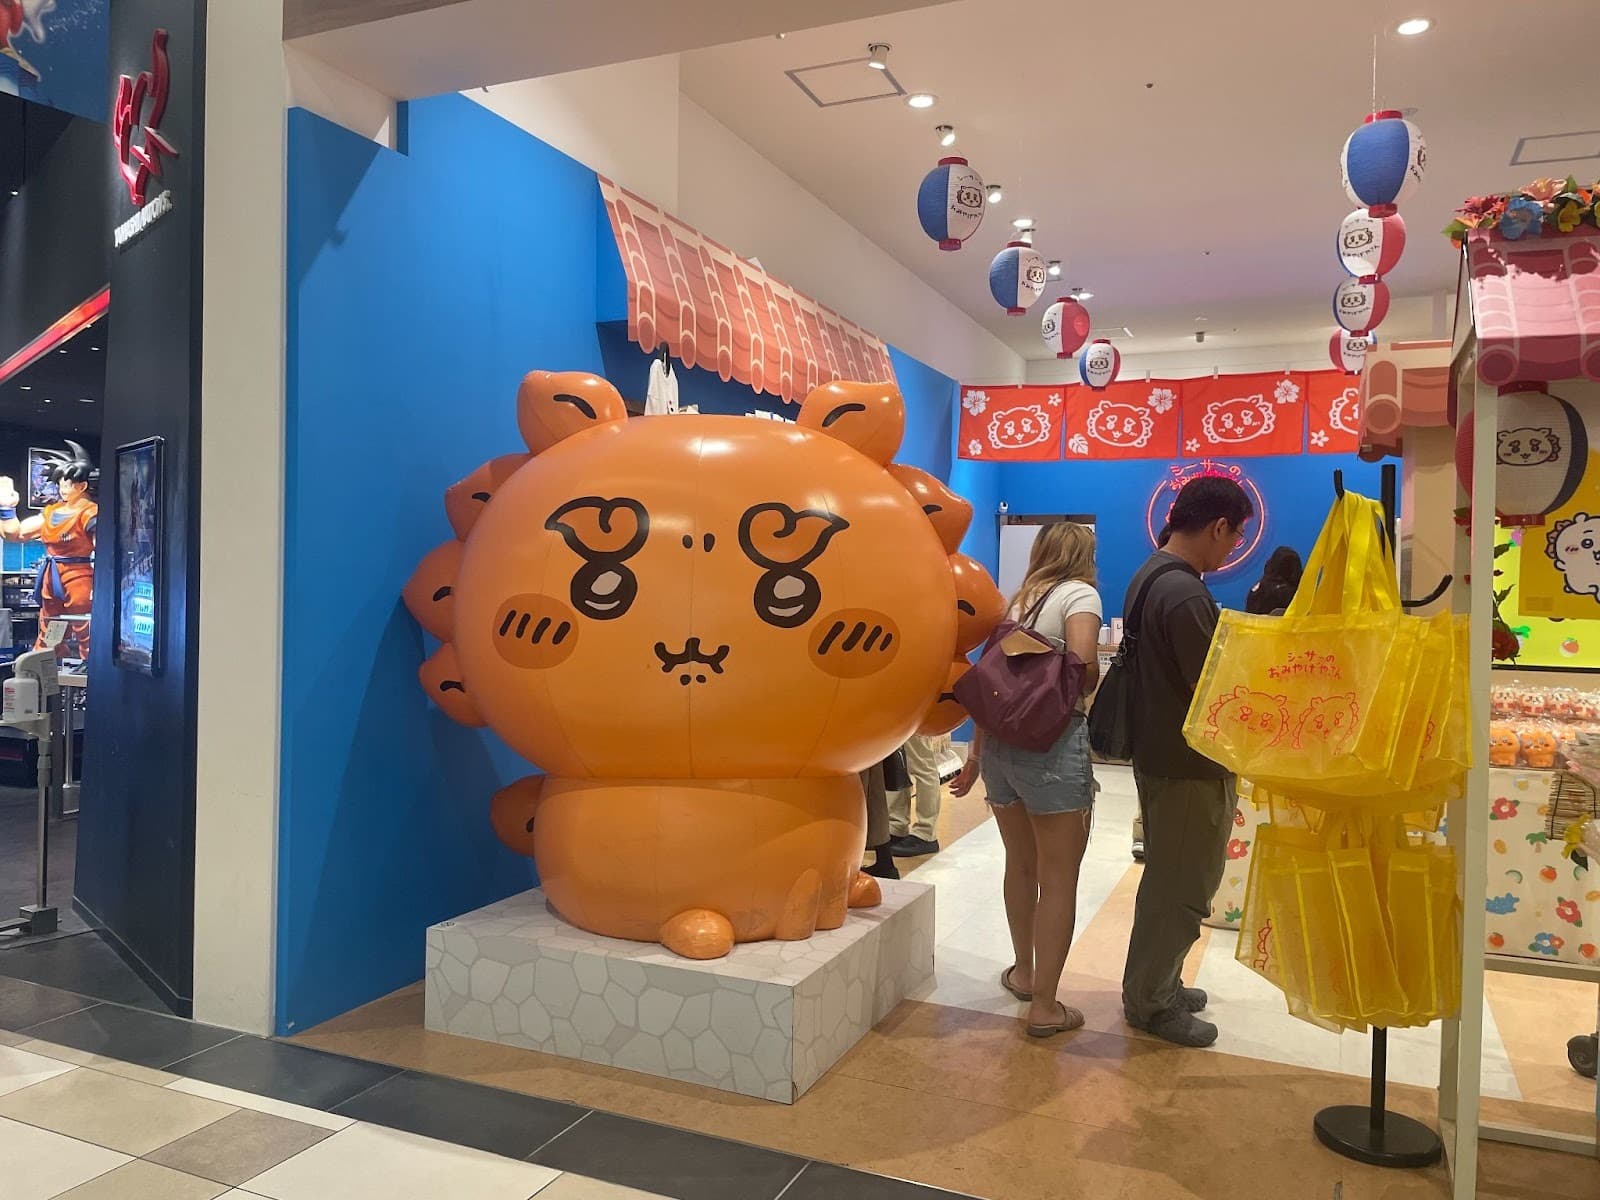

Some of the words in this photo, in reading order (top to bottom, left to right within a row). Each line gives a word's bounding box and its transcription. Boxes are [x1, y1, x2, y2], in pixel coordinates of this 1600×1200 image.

[1170, 459, 1242, 477] シーサーの
[1287, 650, 1335, 662] シーサーの
